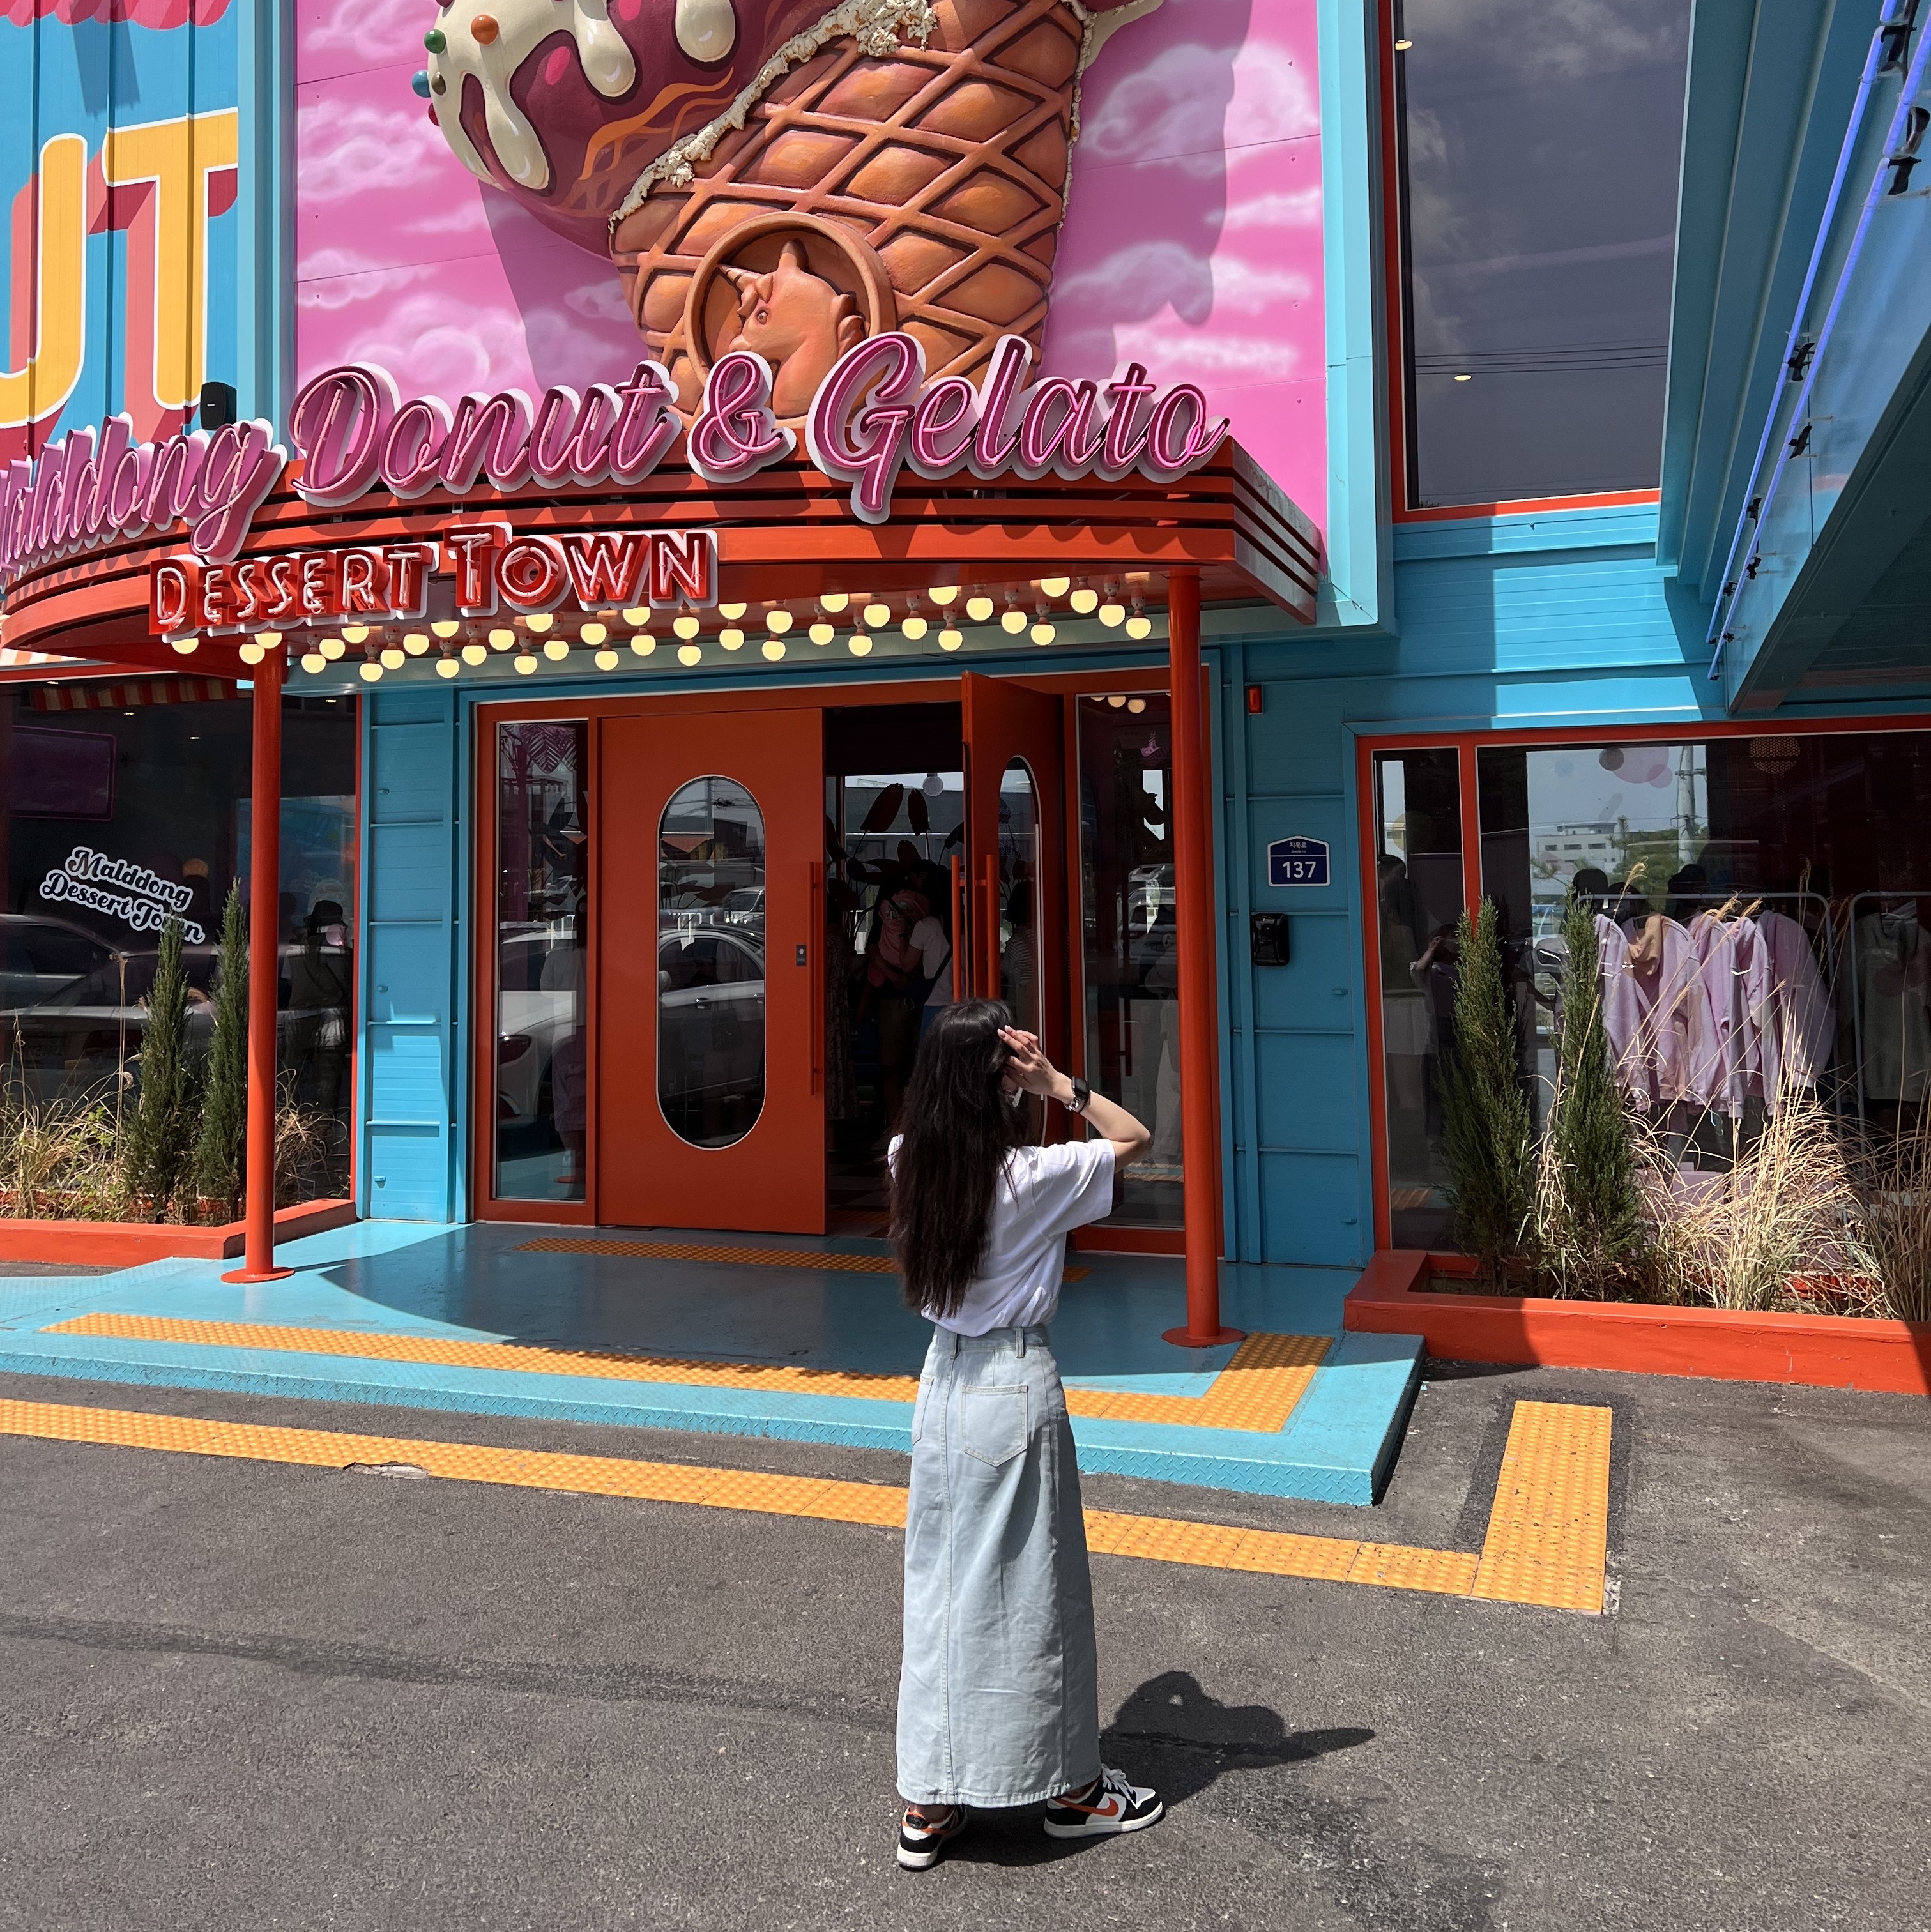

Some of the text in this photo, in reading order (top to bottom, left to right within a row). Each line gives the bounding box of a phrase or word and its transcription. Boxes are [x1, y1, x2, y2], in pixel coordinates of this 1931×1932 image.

[289, 362, 679, 506] Donut
[688, 351, 796, 483] &
[806, 331, 1230, 524] Gelato
[149, 522, 717, 641] DESSERT TOWN
[40, 869, 205, 944] Dessert Ton
[65, 846, 193, 912] Malddong
[1282, 861, 1317, 878] 137
